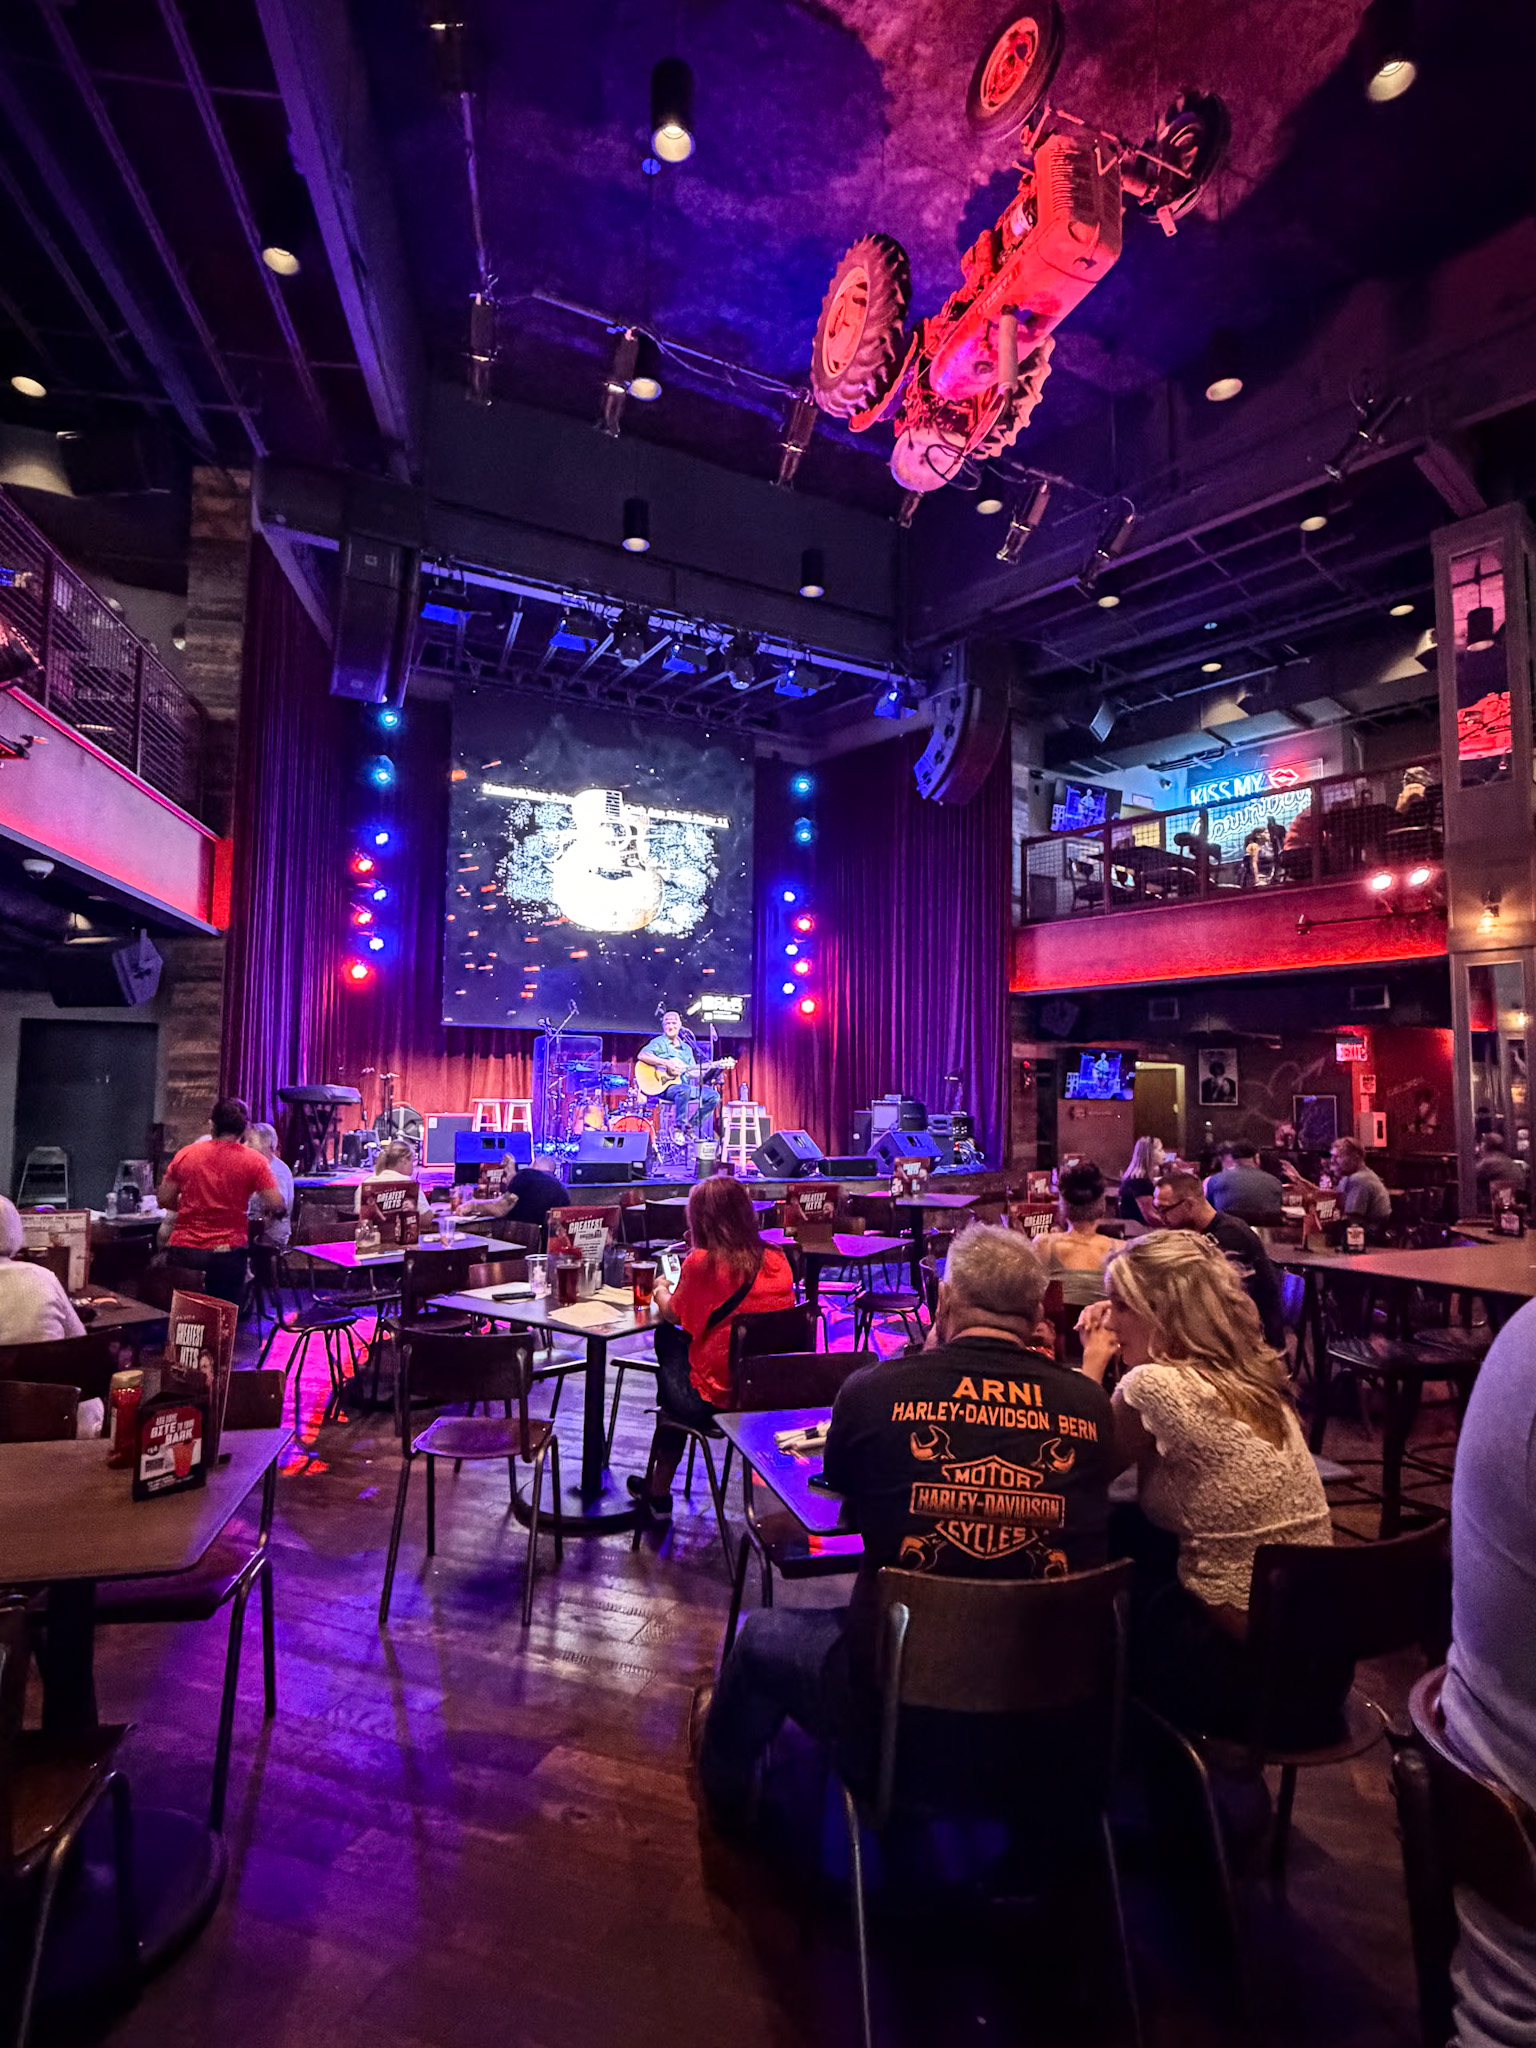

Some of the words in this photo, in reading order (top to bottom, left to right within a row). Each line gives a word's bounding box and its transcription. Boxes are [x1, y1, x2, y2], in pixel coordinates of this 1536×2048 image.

[1190, 781, 1231, 806] KISS
[1233, 772, 1264, 798] MY
[376, 1190, 406, 1204] GREATEST
[382, 1200, 402, 1210] HITS
[568, 1217, 604, 1235] GREATEST
[176, 1323, 205, 1347] GREATEST
[180, 1346, 199, 1370] HITS
[952, 1376, 1043, 1407] ARNI
[150, 1422, 177, 1439] BITE
[891, 1401, 1050, 1431] HARLEY-DAVIDSON
[1058, 1414, 1098, 1443] BERN
[165, 1427, 193, 1446] BARK
[954, 1466, 1035, 1489] MOTOR
[917, 1486, 1060, 1519] HARLEY-DAVIDSON
[948, 1521, 1027, 1552] CYCLES
